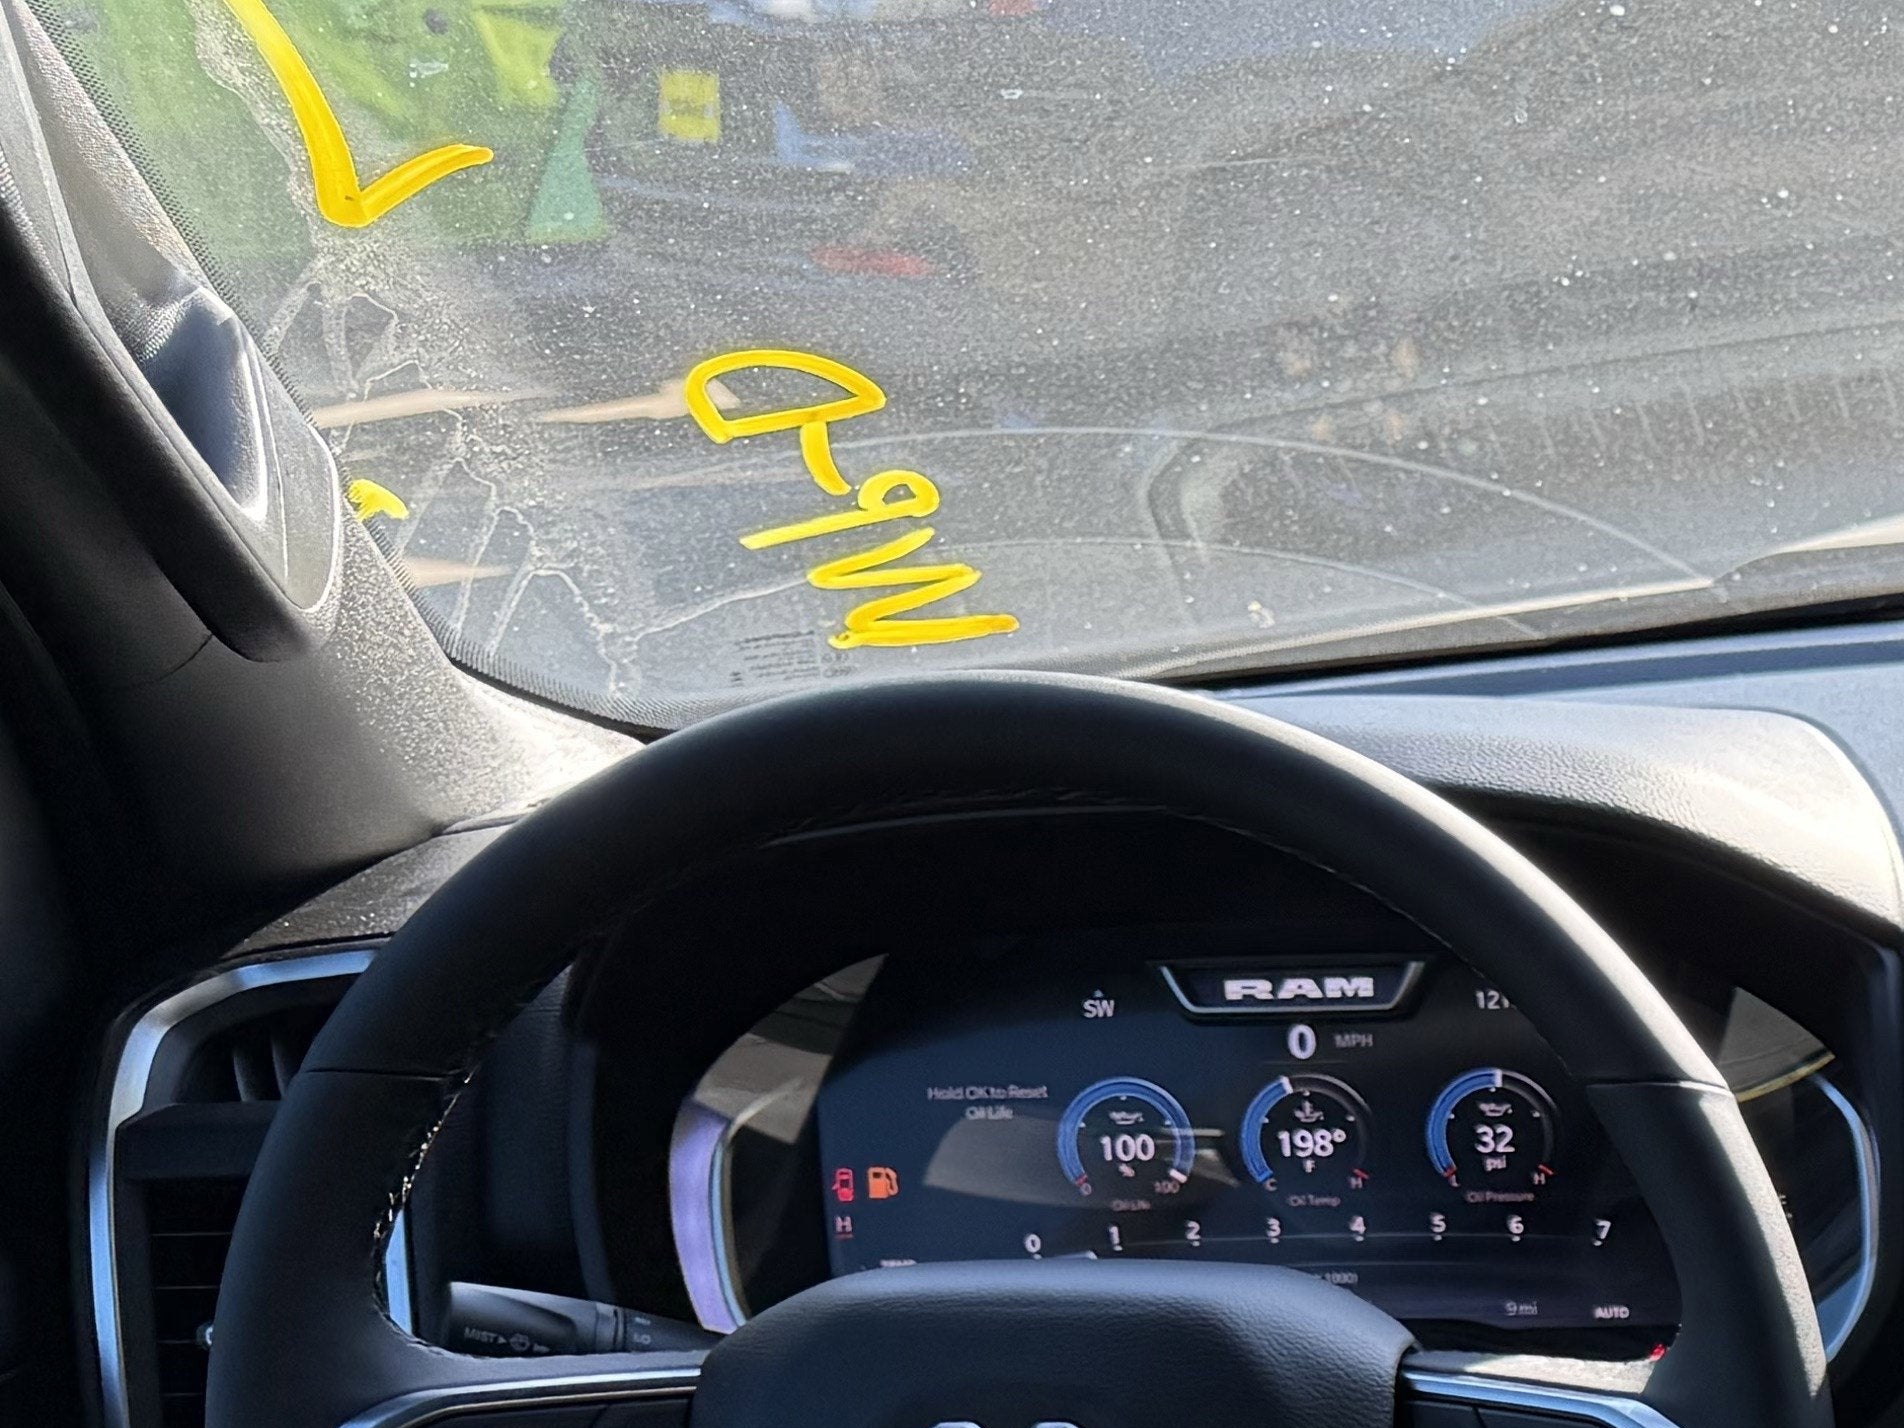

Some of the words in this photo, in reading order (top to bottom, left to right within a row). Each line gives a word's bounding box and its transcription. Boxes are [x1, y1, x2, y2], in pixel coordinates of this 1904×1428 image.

[1224, 977, 1374, 1000] RAM
[1083, 999, 1115, 1018] SW
[1287, 1023, 1317, 1060] 0
[1334, 1033, 1373, 1048] MPH
[1101, 1134, 1155, 1162] 100
[1475, 1124, 1515, 1154] 32
[1483, 1155, 1506, 1172] psi
[1186, 1220, 1200, 1241] 2
[1267, 1216, 1281, 1237] 3
[1350, 1215, 1366, 1234] 4
[1430, 1212, 1446, 1232] 5
[1508, 1213, 1524, 1234] 6
[1595, 1218, 1611, 1239] 7
[1024, 1234, 1041, 1252] 0
[1108, 1224, 1120, 1245] 1
[1518, 1301, 1538, 1315] mi
[1594, 1305, 1629, 1319] AUTO
[464, 1327, 496, 1343] MIST
